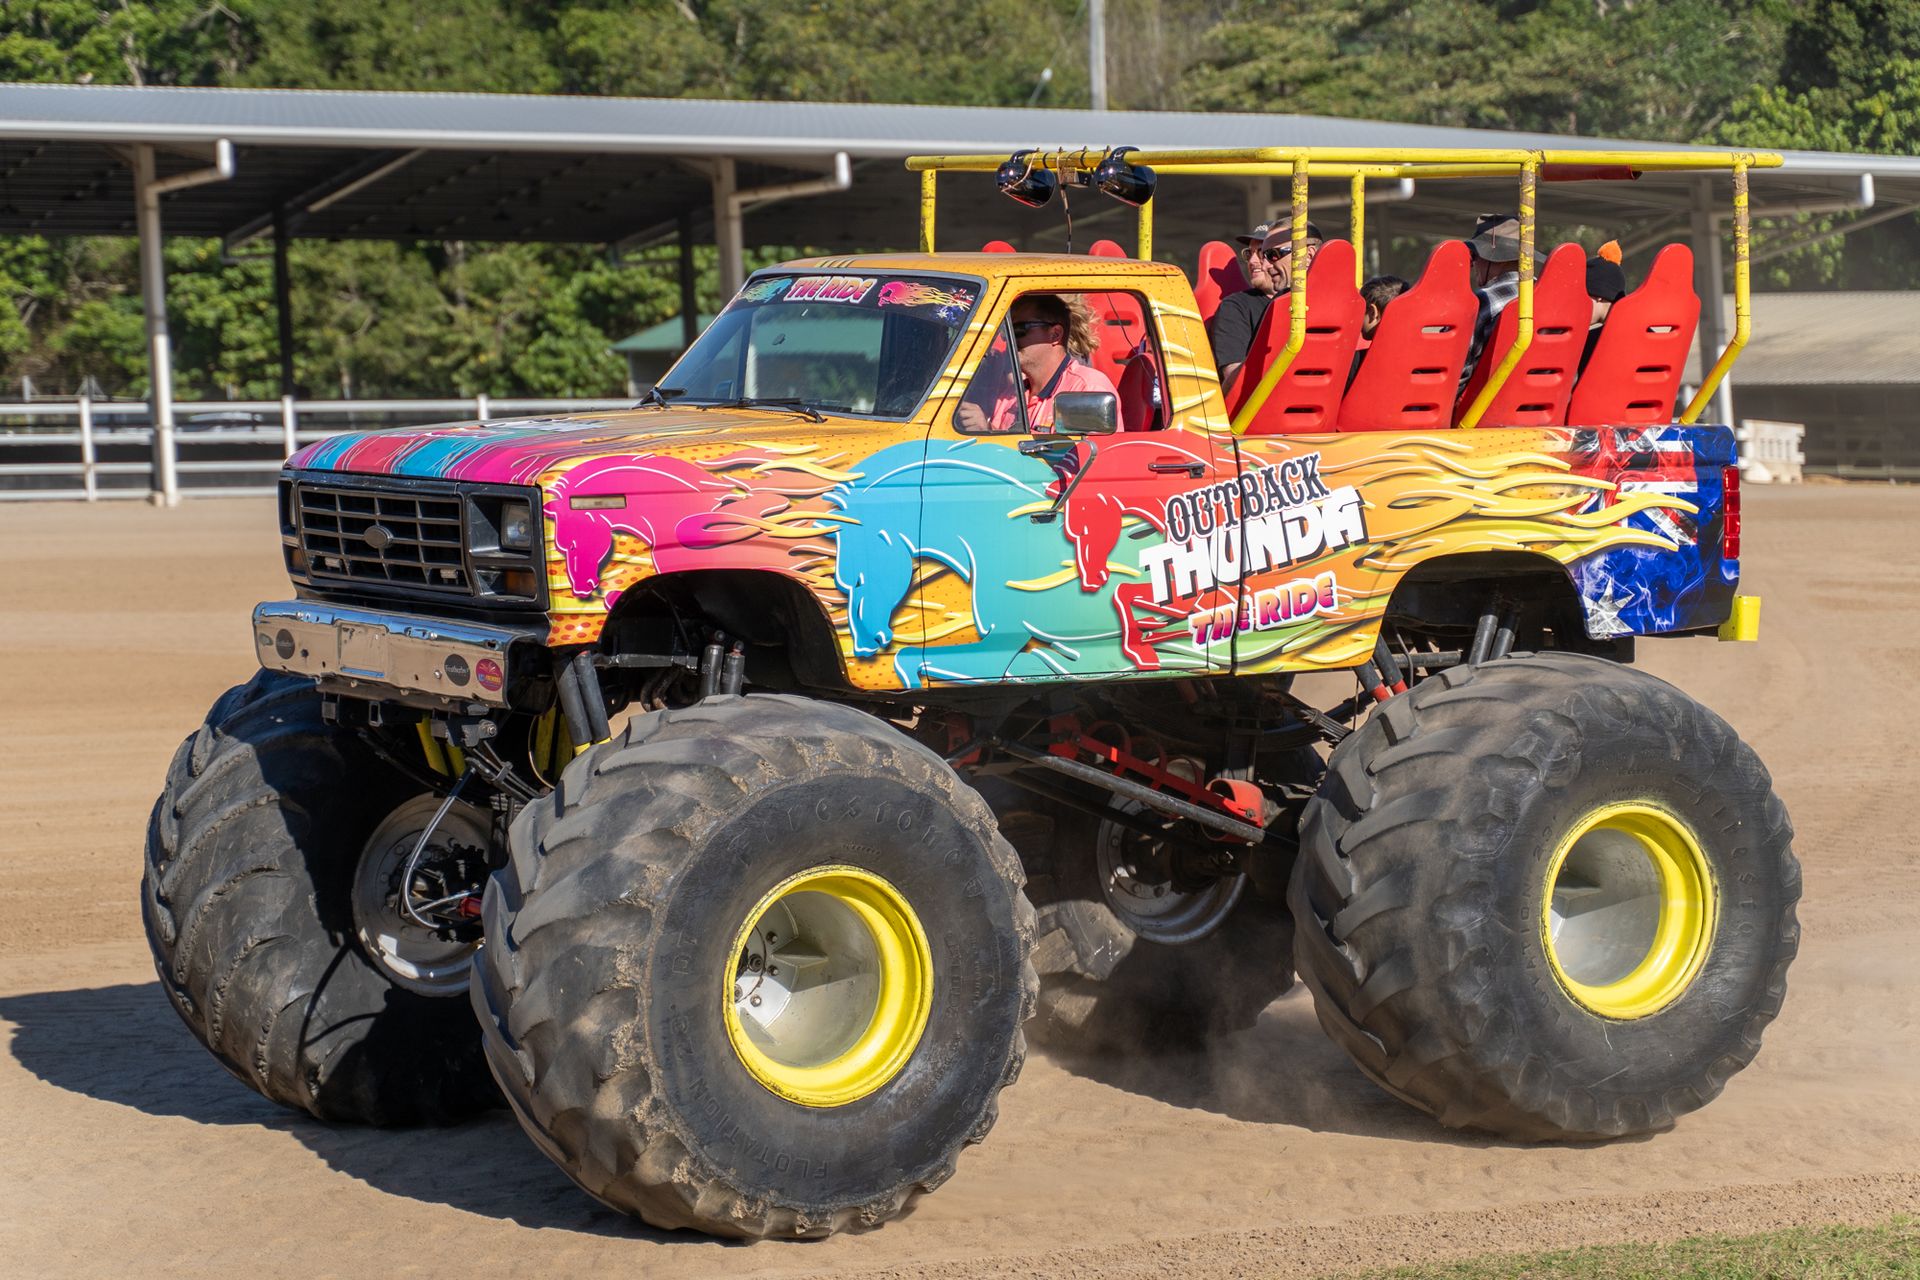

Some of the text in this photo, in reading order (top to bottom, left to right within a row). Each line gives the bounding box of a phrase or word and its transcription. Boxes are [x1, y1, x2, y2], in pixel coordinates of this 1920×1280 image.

[784, 276, 877, 303] THE RIDE
[1166, 453, 1330, 544] OUTBACK
[1139, 485, 1369, 607] THUNDA
[1189, 573, 1336, 648] THE RIDE
[689, 1076, 828, 1182] FLOTATION
